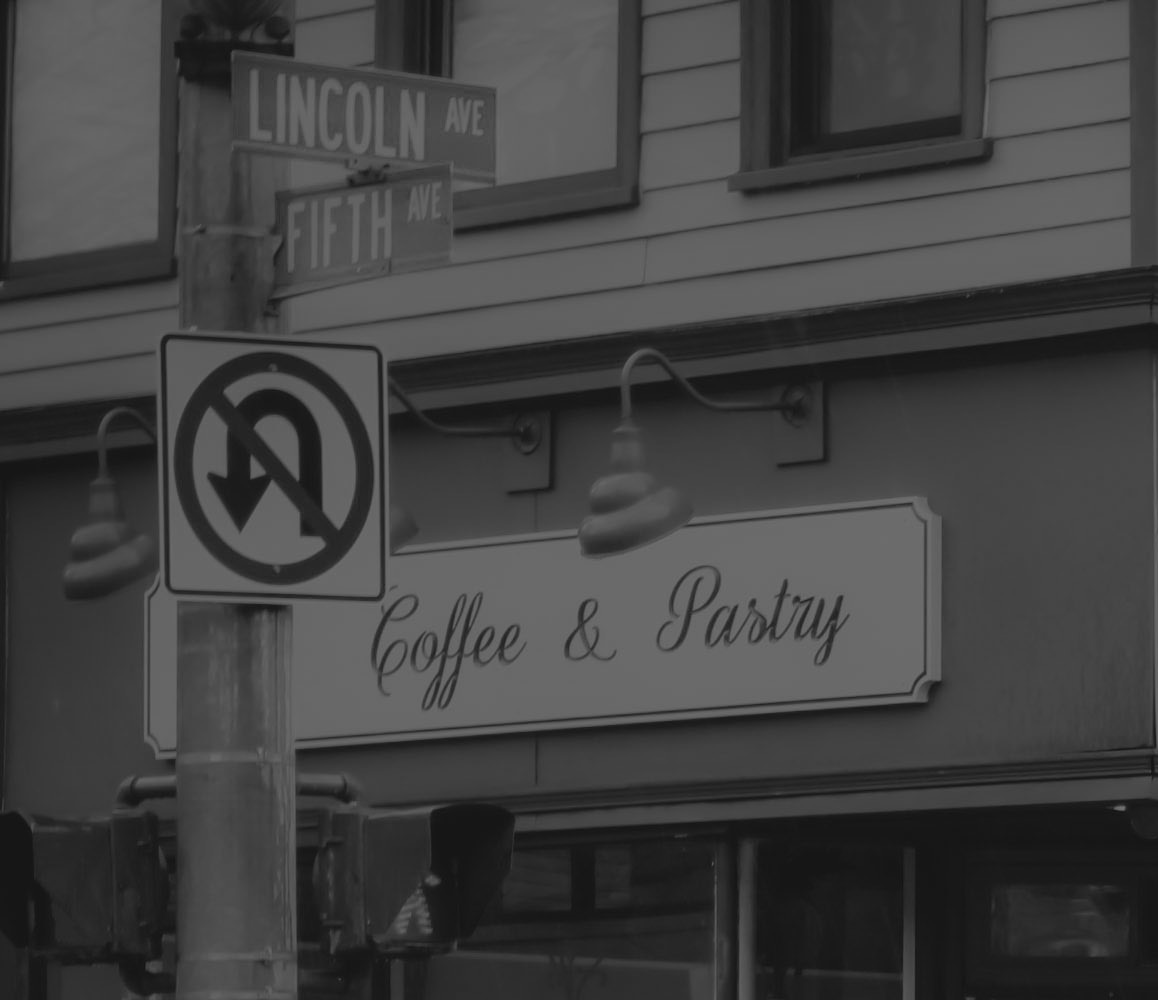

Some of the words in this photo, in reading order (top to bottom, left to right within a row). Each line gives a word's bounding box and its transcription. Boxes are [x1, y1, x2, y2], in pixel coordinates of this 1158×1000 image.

[249, 68, 426, 161] LINCOLN
[444, 96, 485, 137] AVE
[287, 188, 392, 273] FIFTH
[408, 181, 443, 223] AVE
[370, 585, 527, 711] Coffee
[564, 598, 617, 662] &
[656, 564, 851, 666] Pastry
